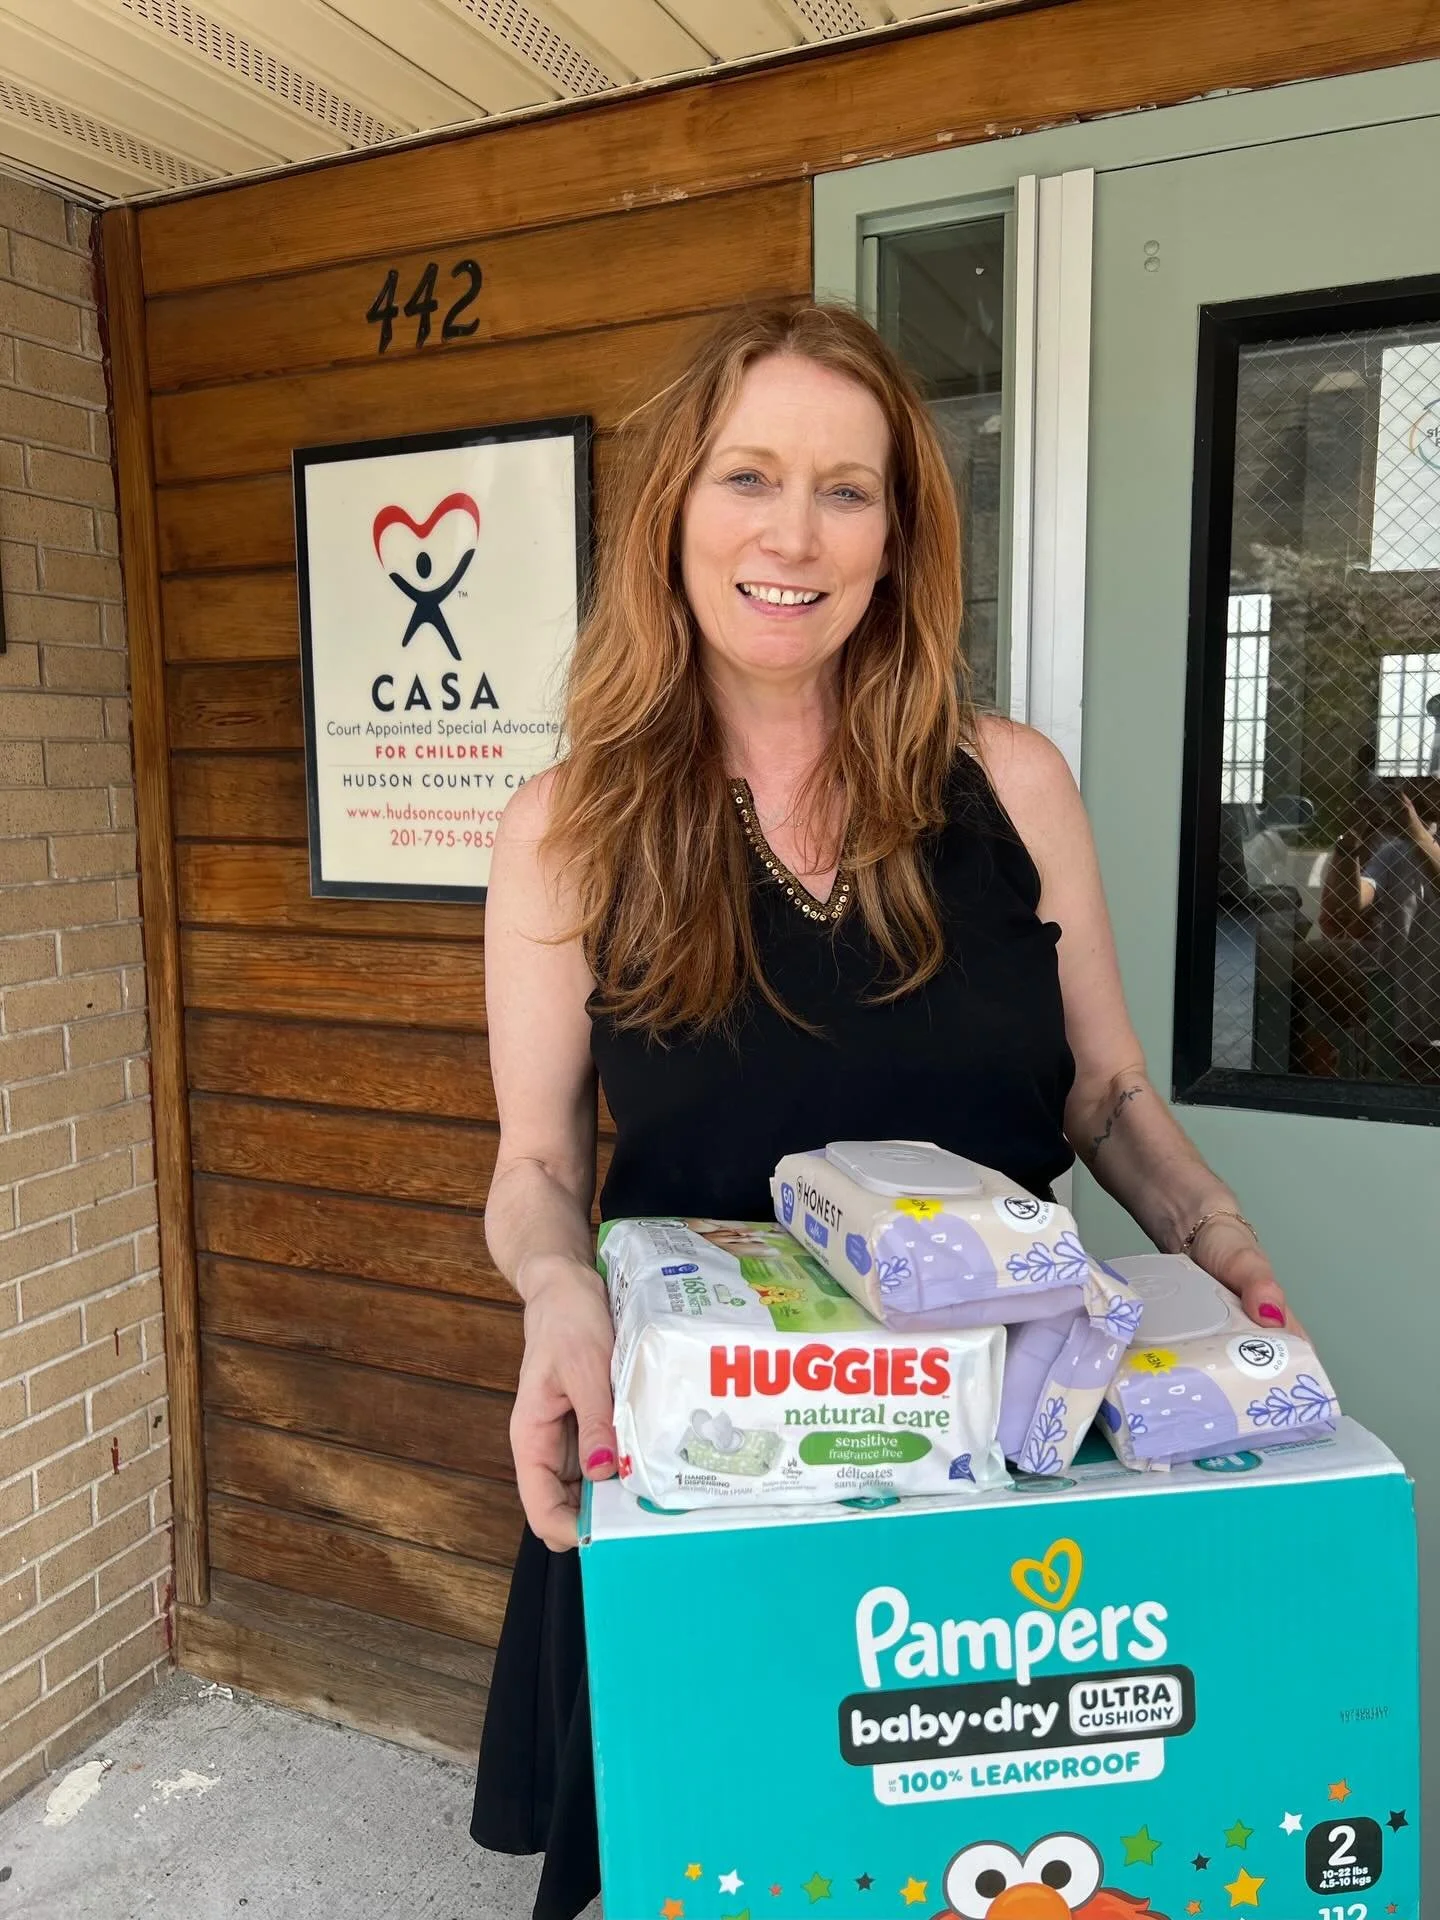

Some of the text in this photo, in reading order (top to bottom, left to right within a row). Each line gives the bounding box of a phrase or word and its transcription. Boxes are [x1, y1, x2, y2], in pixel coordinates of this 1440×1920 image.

[366, 259, 482, 355] 442
[371, 672, 500, 712] CASA
[326, 719, 560, 738] Court Appointed Special Advocate
[375, 744, 503, 759] FOR CHILDREN
[343, 774, 534, 788] HUDSON COUNTY CA
[347, 803, 503, 824] www.hudsoncountyca
[391, 829, 494, 849] 201-795-985
[803, 1182, 843, 1232] HONEST
[682, 1275, 707, 1295] 168
[710, 1343, 951, 1397] HUGGIES
[1143, 1352, 1165, 1369] NEW
[784, 1404, 950, 1428] natural care
[835, 1433, 898, 1449] sensitive
[829, 1447, 903, 1460] fragrance free
[836, 1466, 893, 1480] délicates
[855, 1586, 1168, 1688] Pampers
[1080, 1682, 1171, 1710] ULTRA
[1078, 1705, 1174, 1728] CUSHIONY
[898, 1751, 1141, 1794] 100% LEAKPROOF
[1328, 1825, 1357, 1867] 2
[1319, 1875, 1371, 1889] 4.5-10 kgs
[1322, 1866, 1369, 1880] 10-22 lbs
